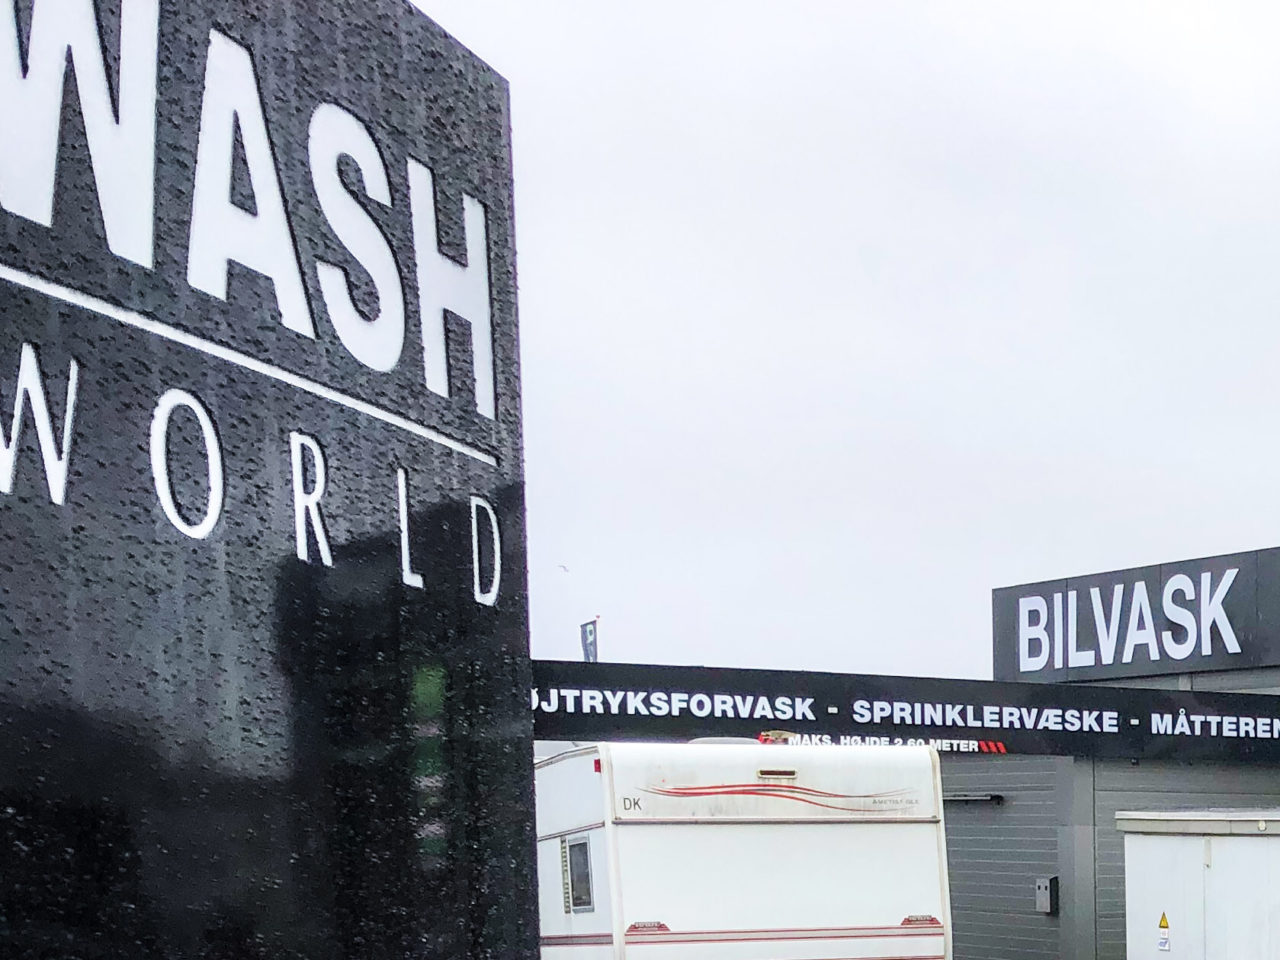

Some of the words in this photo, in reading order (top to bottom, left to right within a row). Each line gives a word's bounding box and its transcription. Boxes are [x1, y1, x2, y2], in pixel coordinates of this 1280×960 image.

[0, 0, 498, 421] WASH
[1017, 567, 1242, 673] BILVASK
[852, 699, 1120, 734] SPRINKLERVÆSKE
[929, 739, 979, 752] METER
[623, 797, 642, 811] DK
